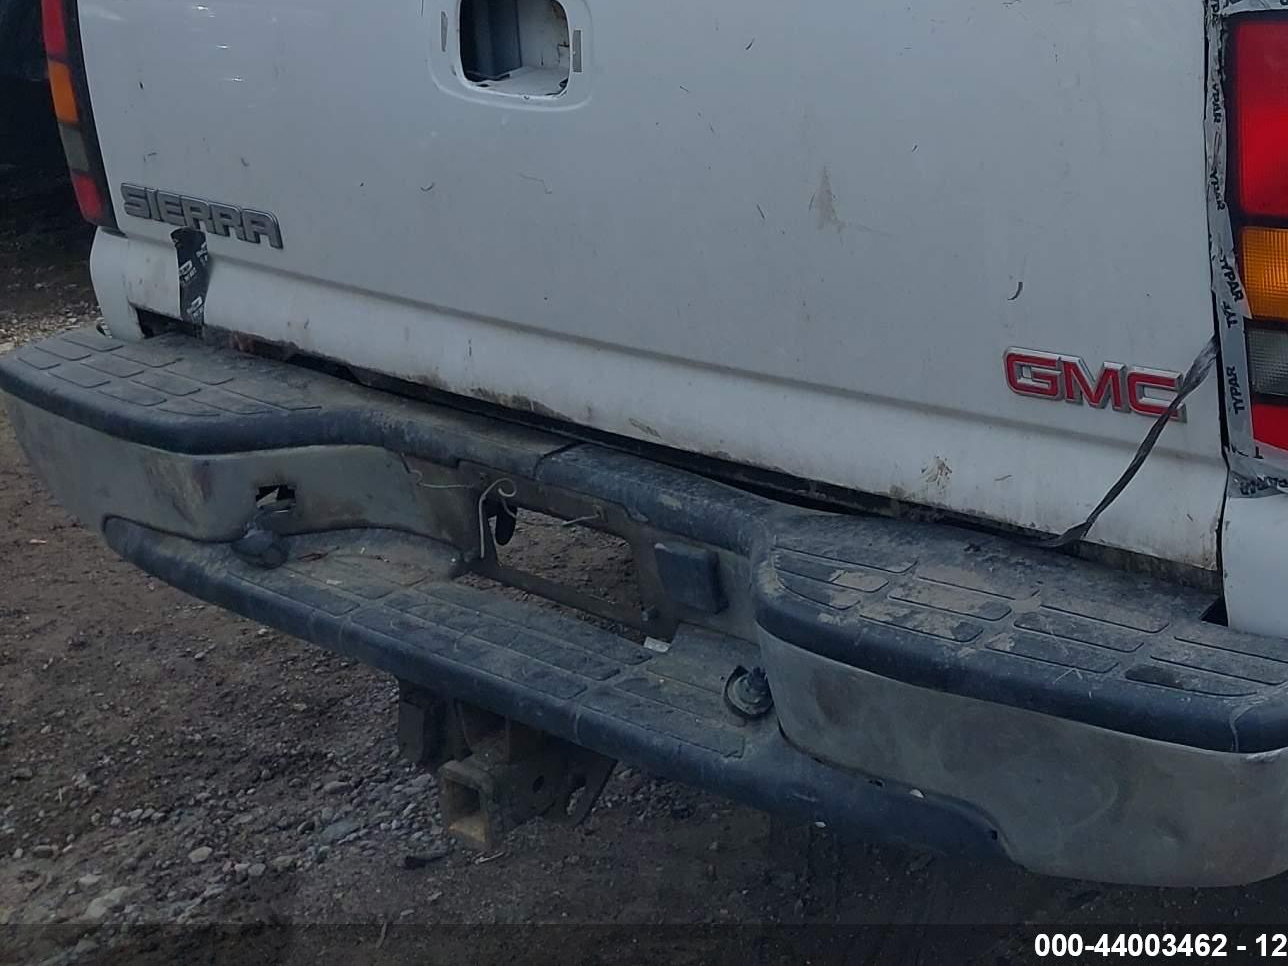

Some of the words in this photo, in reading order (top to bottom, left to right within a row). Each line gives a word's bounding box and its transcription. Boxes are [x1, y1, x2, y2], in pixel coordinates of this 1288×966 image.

[120, 182, 284, 250] SIERRA
[1219, 254, 1244, 302] TYPAR
[1003, 345, 1187, 424] GMC
[1226, 365, 1245, 415] TYPAR
